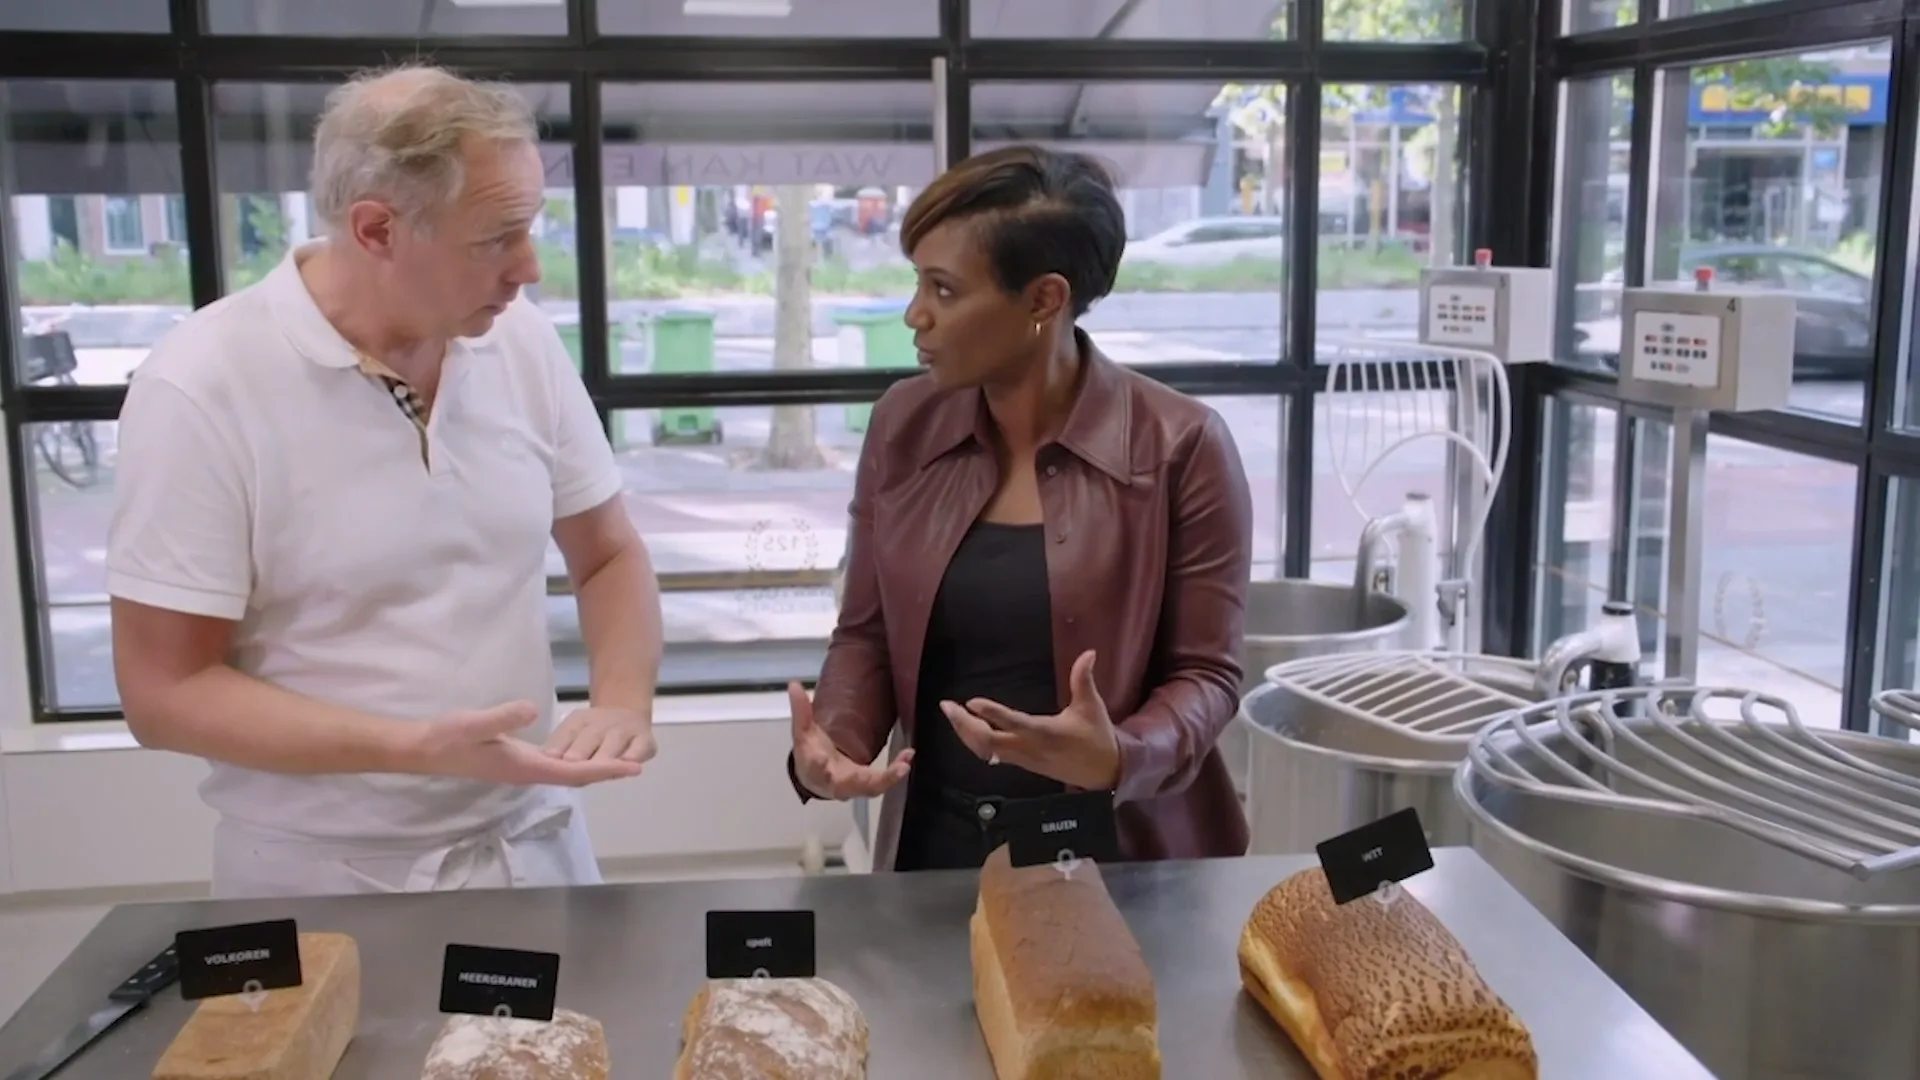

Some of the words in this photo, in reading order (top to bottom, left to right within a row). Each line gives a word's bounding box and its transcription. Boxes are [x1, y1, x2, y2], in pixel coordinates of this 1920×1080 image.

[1041, 819, 1078, 833] BRUIN
[1361, 847, 1383, 862] WIT
[204, 948, 270, 965] VOLKOREN
[458, 972, 537, 988] MEERGRANEN
